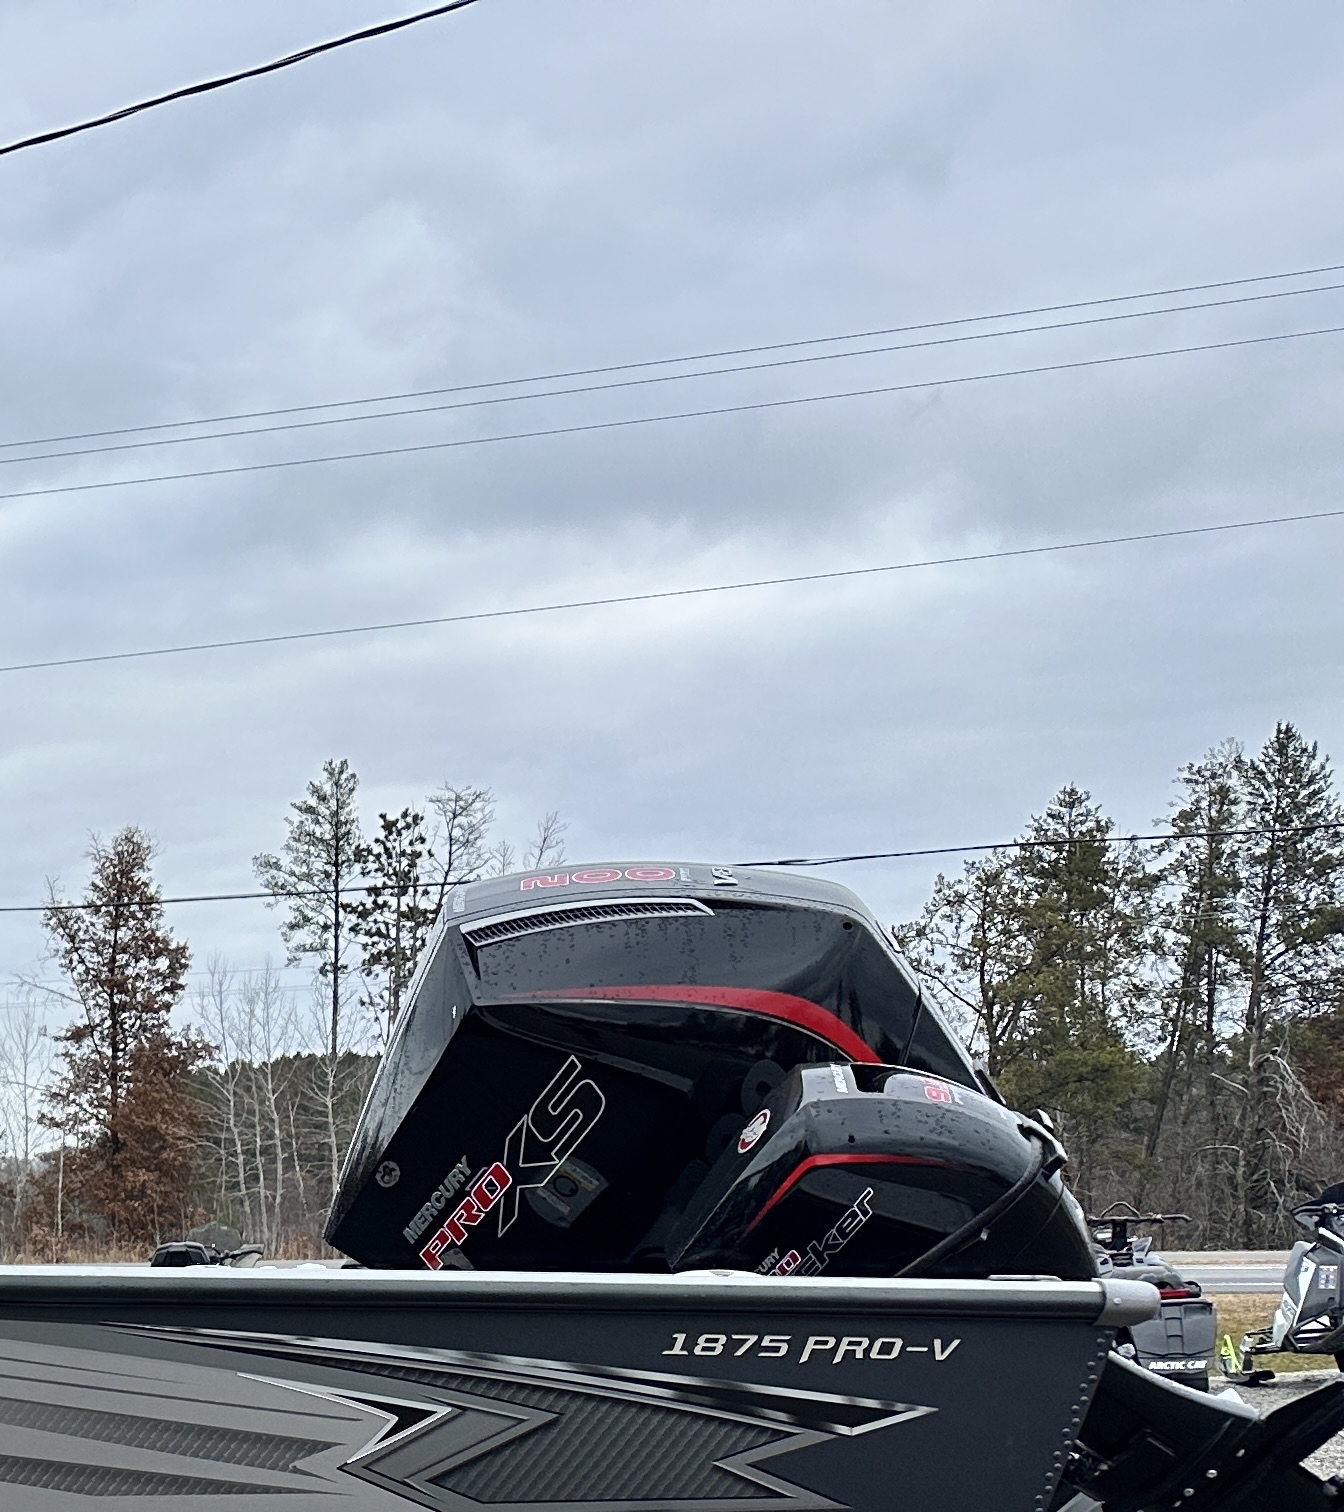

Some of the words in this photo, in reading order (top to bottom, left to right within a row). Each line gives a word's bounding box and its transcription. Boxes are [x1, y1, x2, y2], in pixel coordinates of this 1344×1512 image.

[419, 1161, 513, 1271] PRO
[497, 1054, 606, 1238] XS
[402, 1154, 473, 1245] MERCURY
[662, 1332, 792, 1358] 1875
[798, 1335, 962, 1365] PRO-V
[1148, 1360, 1186, 1370] ARCTIC
[1186, 1360, 1208, 1369] CAT
